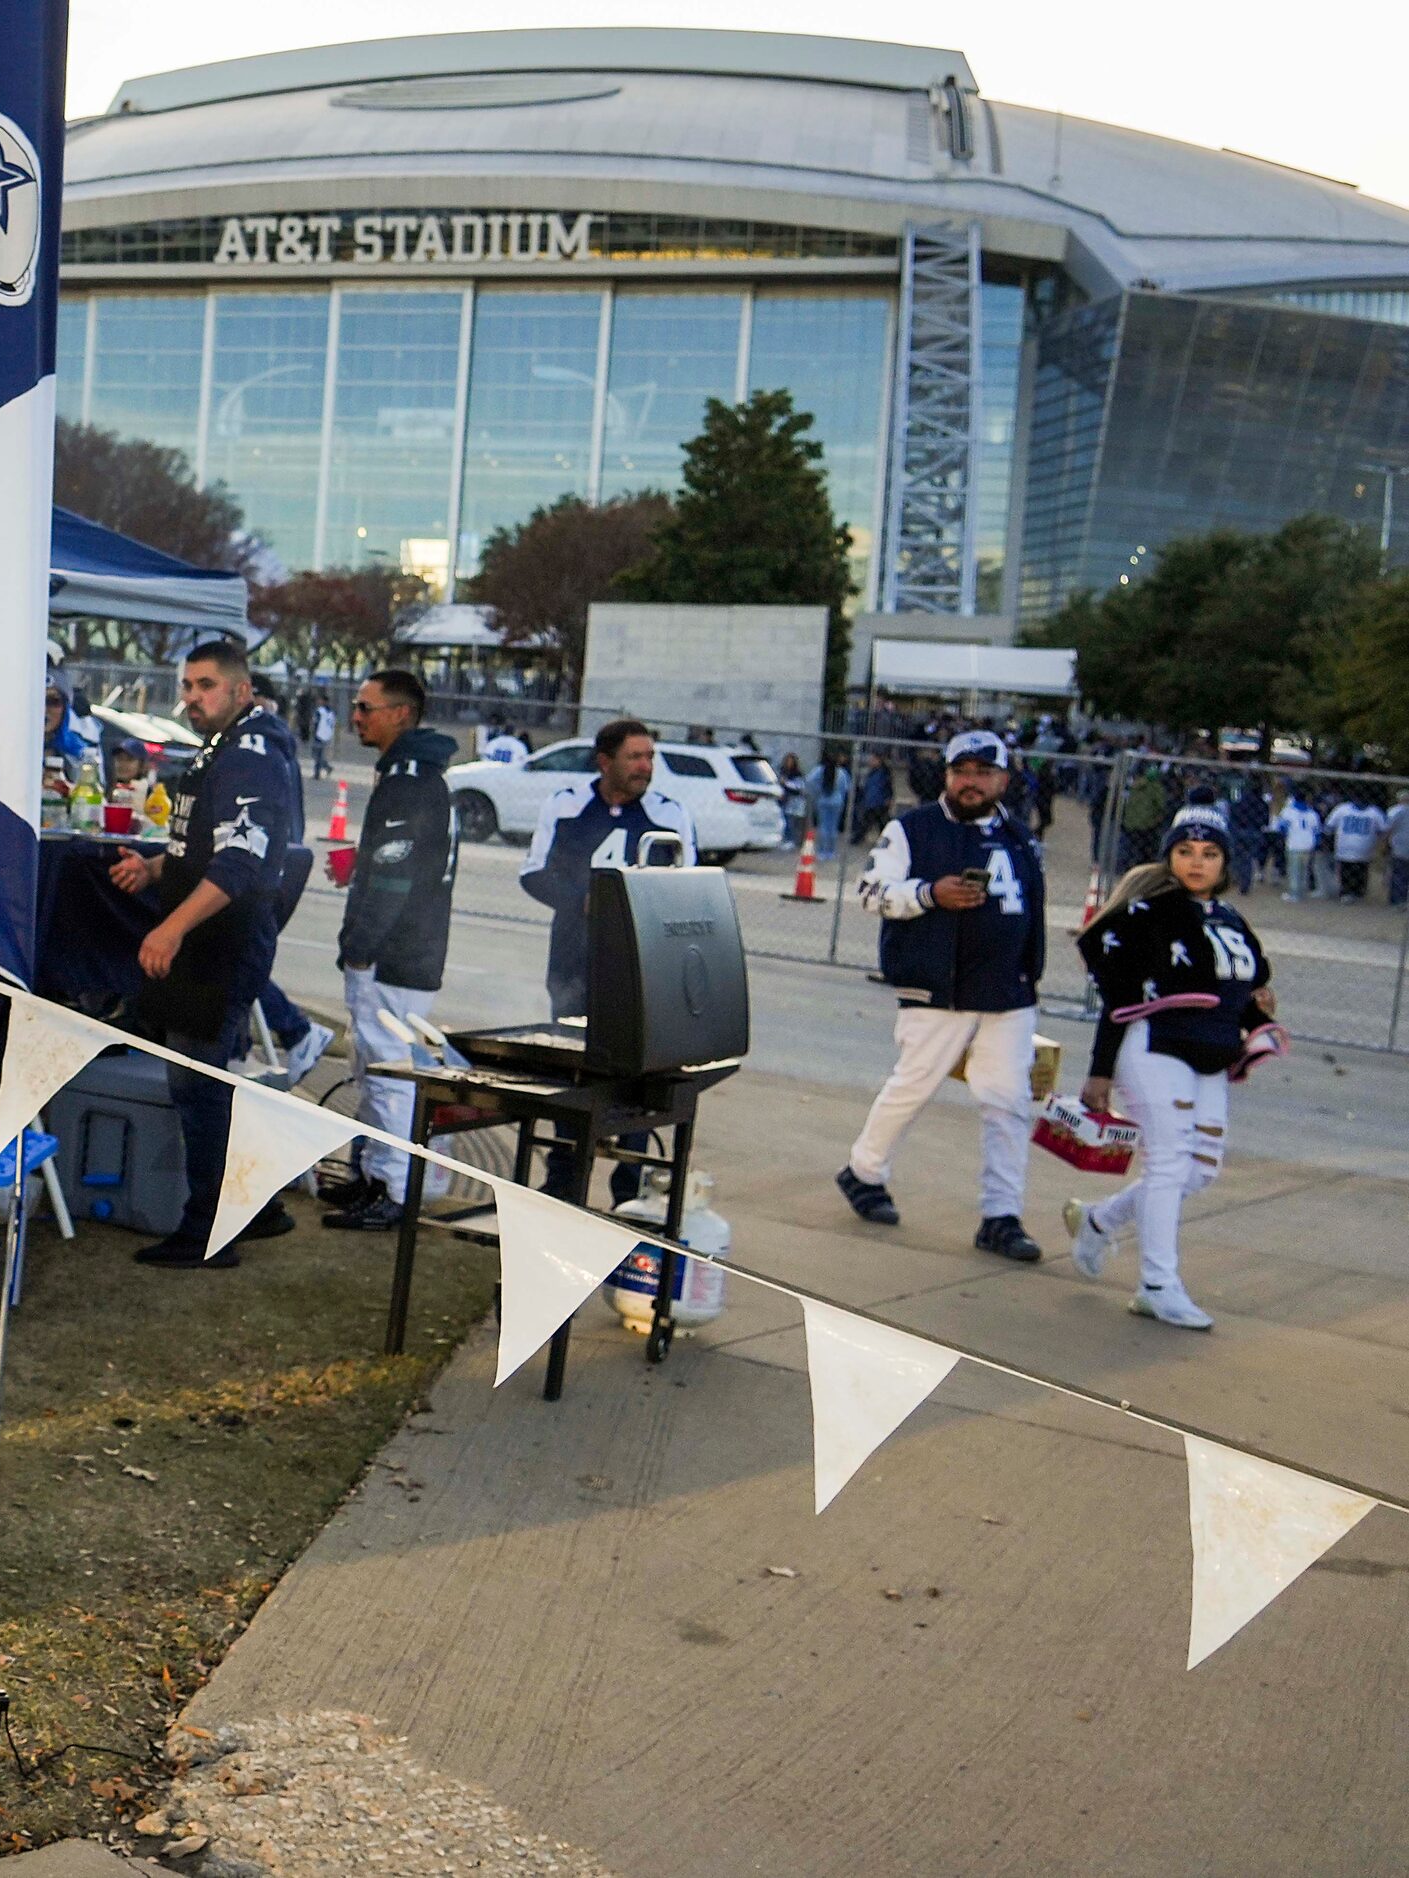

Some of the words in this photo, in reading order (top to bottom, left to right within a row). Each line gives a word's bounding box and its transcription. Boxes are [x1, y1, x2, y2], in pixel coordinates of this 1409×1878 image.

[214, 217, 342, 265] AT&T
[353, 213, 593, 264] STADIUM
[986, 849, 1025, 916] 4
